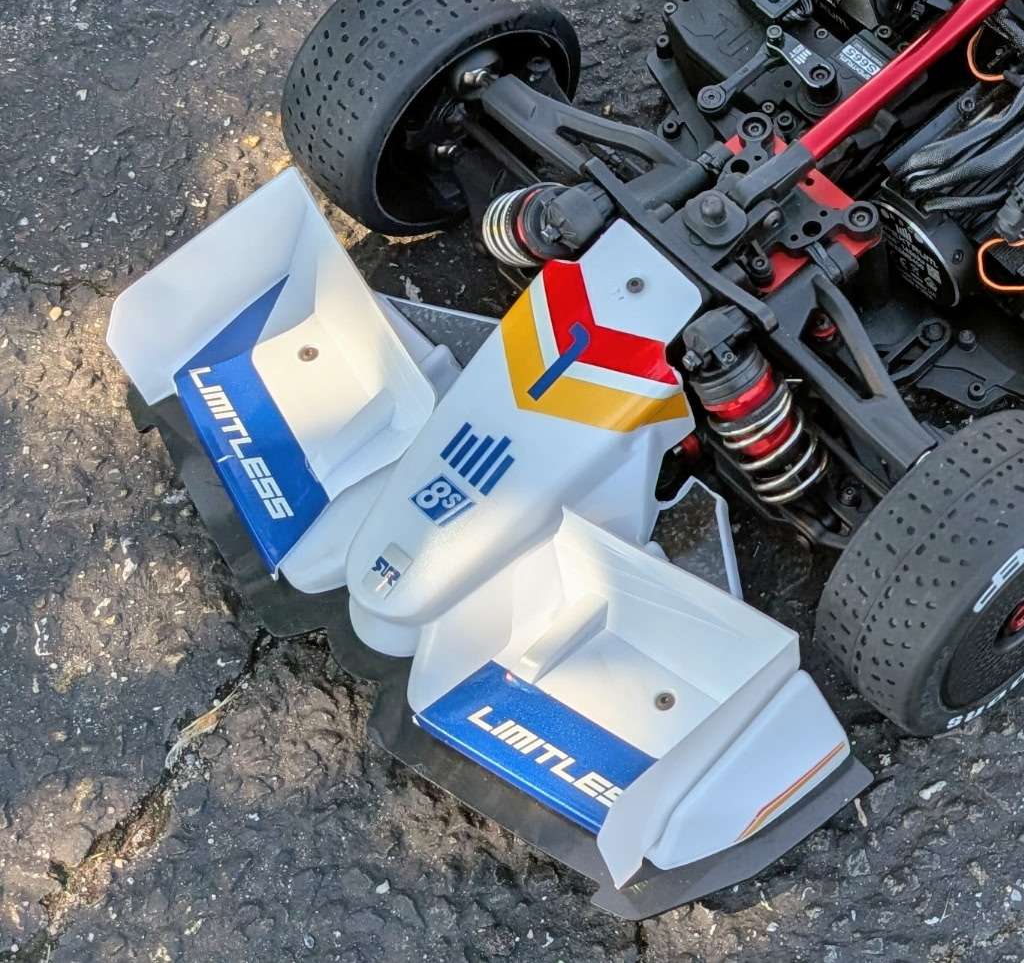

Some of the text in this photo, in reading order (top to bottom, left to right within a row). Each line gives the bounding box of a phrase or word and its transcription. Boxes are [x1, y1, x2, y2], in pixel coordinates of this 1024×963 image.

[847, 47, 878, 76] S665
[189, 367, 294, 520] LIMITLESS
[467, 706, 623, 808] LIMITLES
